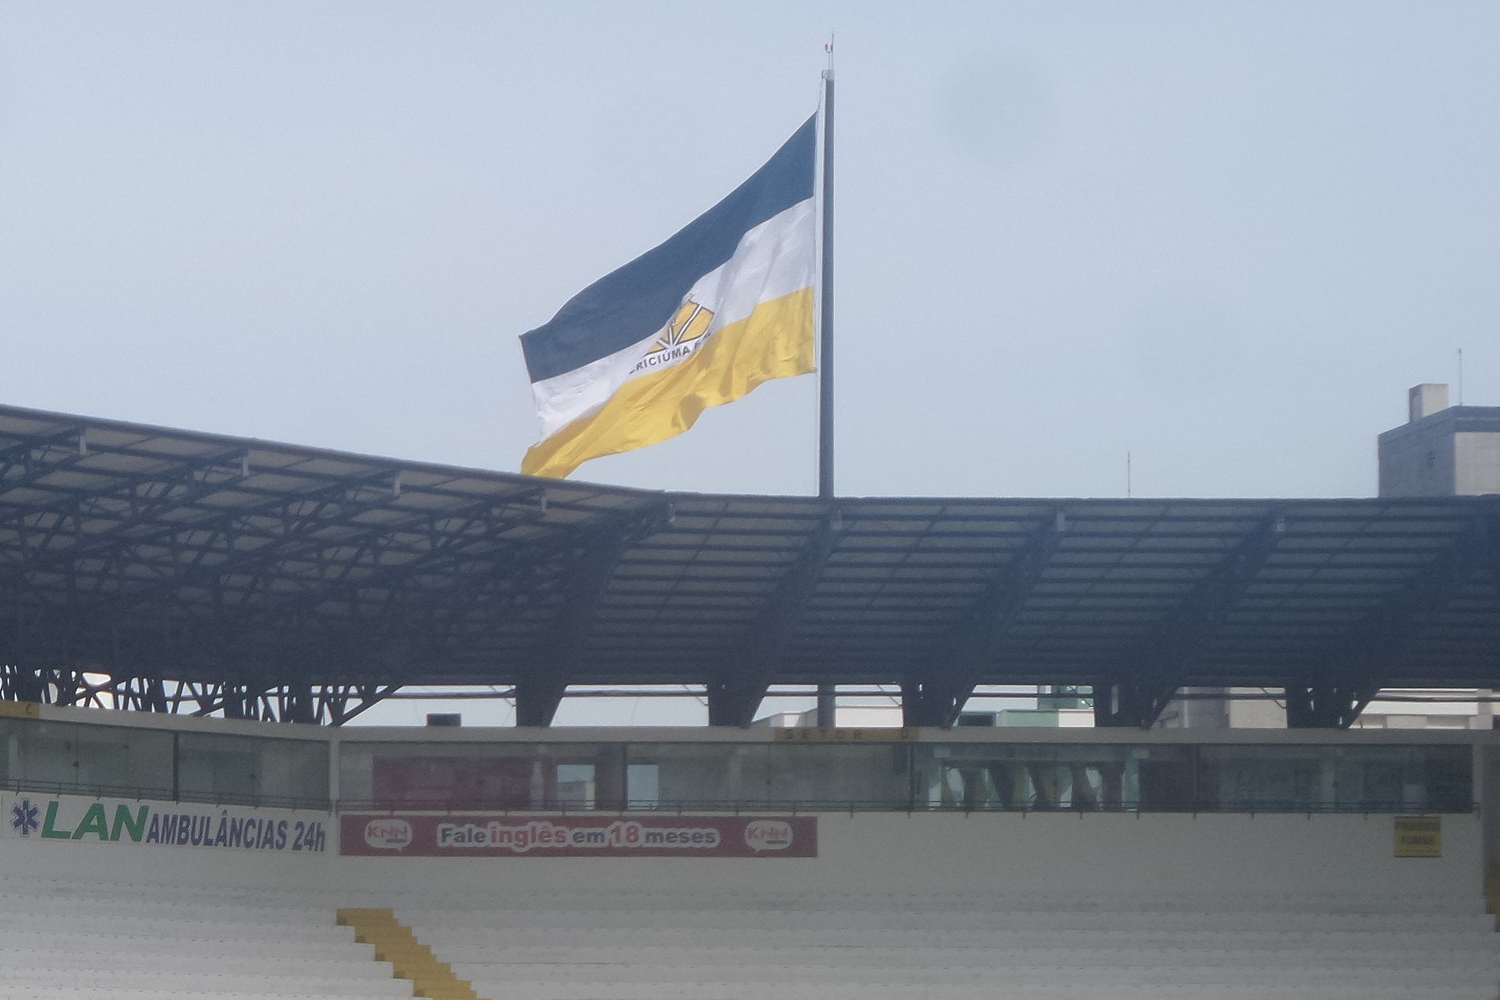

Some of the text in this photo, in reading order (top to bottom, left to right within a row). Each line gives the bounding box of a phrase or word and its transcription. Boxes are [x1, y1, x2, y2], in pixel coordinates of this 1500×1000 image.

[629, 346, 691, 375] RICIÚMA
[40, 801, 325, 852] LAN AMBULÂNCIAS 24h
[441, 824, 716, 848] Fale inglês em 18 meses
